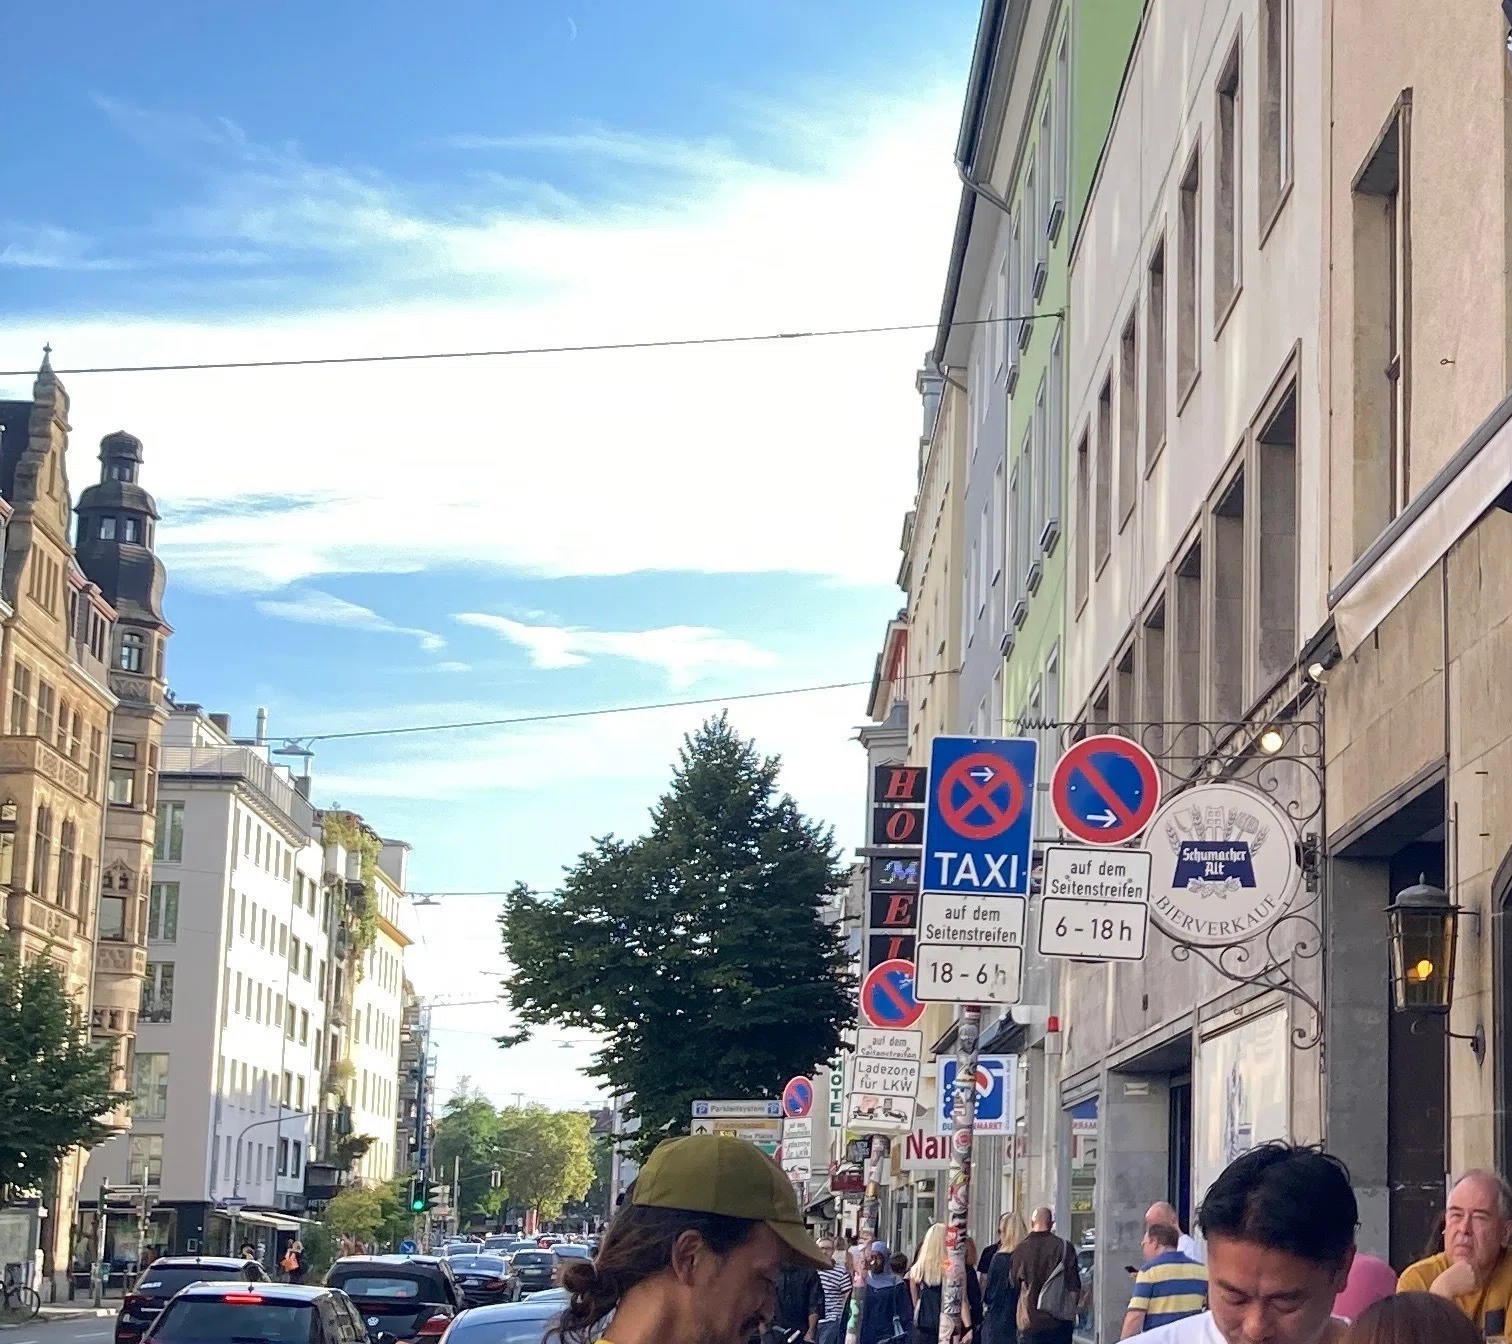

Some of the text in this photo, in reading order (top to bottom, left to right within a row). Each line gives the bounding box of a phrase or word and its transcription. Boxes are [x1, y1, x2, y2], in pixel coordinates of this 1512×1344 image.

[1182, 847, 1248, 863] Schumacher
[934, 851, 1020, 889] TAXI
[1070, 860, 1127, 878] auf dem
[1204, 861, 1226, 877] Alt
[1051, 879, 1143, 899] Seitenstreifen
[945, 905, 1001, 923] auf dem
[1156, 894, 1277, 937] BIERVERKAUF
[925, 924, 1018, 945] Seitenstreifen
[1055, 916, 1069, 939] 6
[1091, 918, 1115, 941] 18
[1120, 919, 1133, 942] h
[930, 961, 954, 986] 18
[976, 961, 989, 986] 6
[872, 1035, 907, 1047] auf dem
[857, 1060, 916, 1077] Ladezone
[830, 1056, 843, 1128] HOTEL
[883, 1078, 913, 1093] LKW
